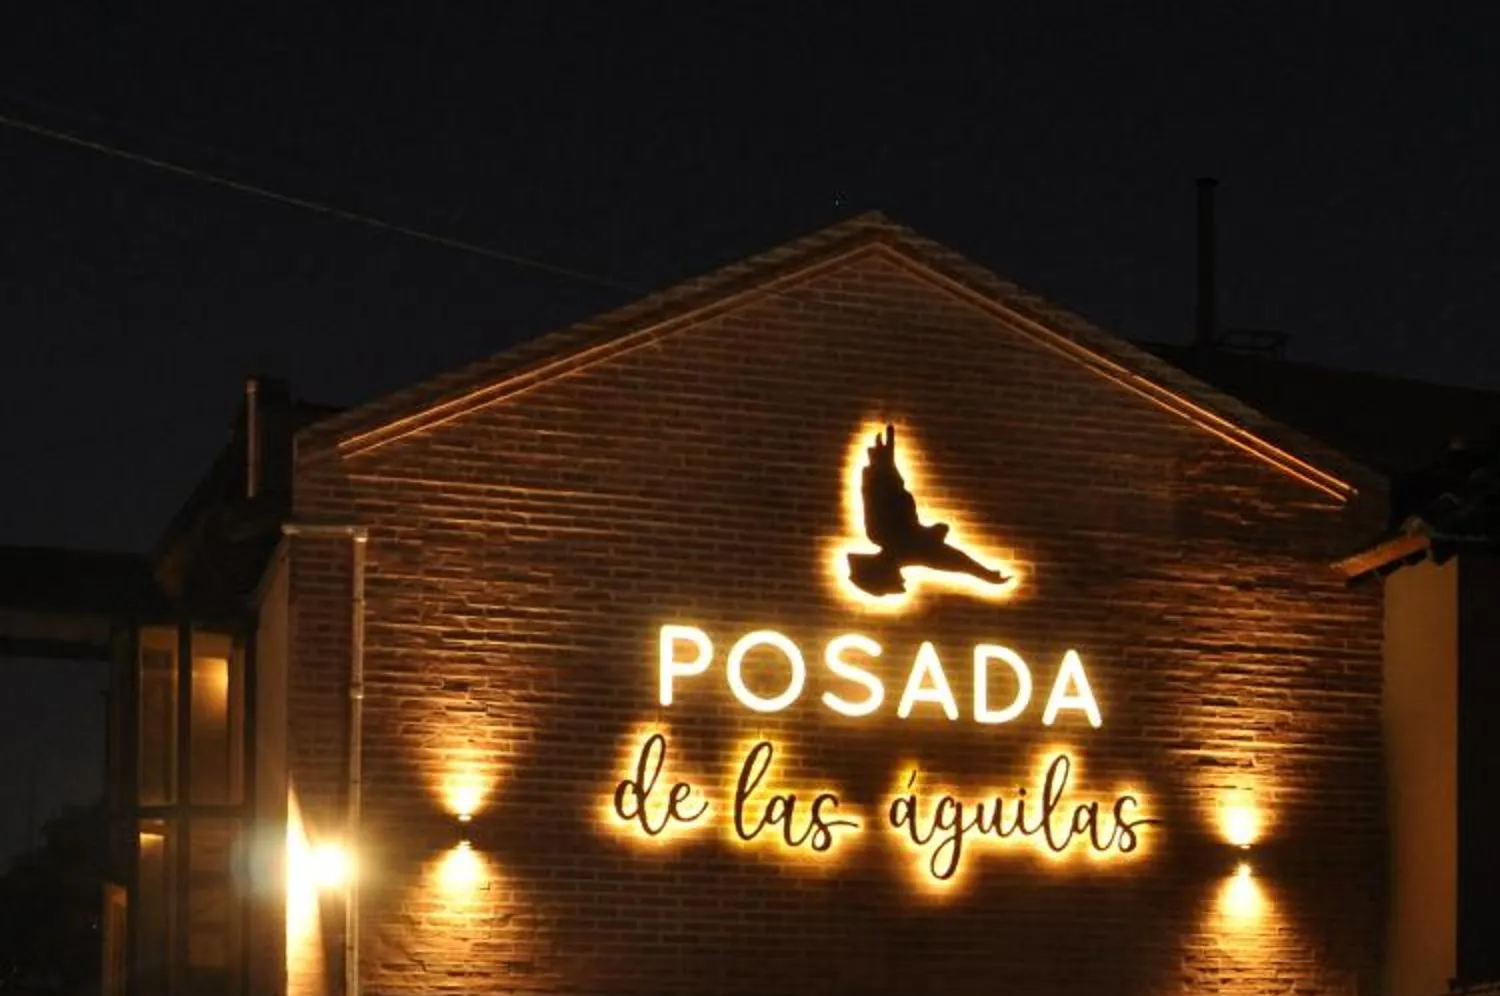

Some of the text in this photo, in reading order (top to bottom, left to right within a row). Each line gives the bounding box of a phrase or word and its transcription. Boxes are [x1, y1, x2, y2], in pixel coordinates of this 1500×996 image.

[660, 625, 1101, 728] POSADA
[613, 733, 1160, 880] de las águilas
